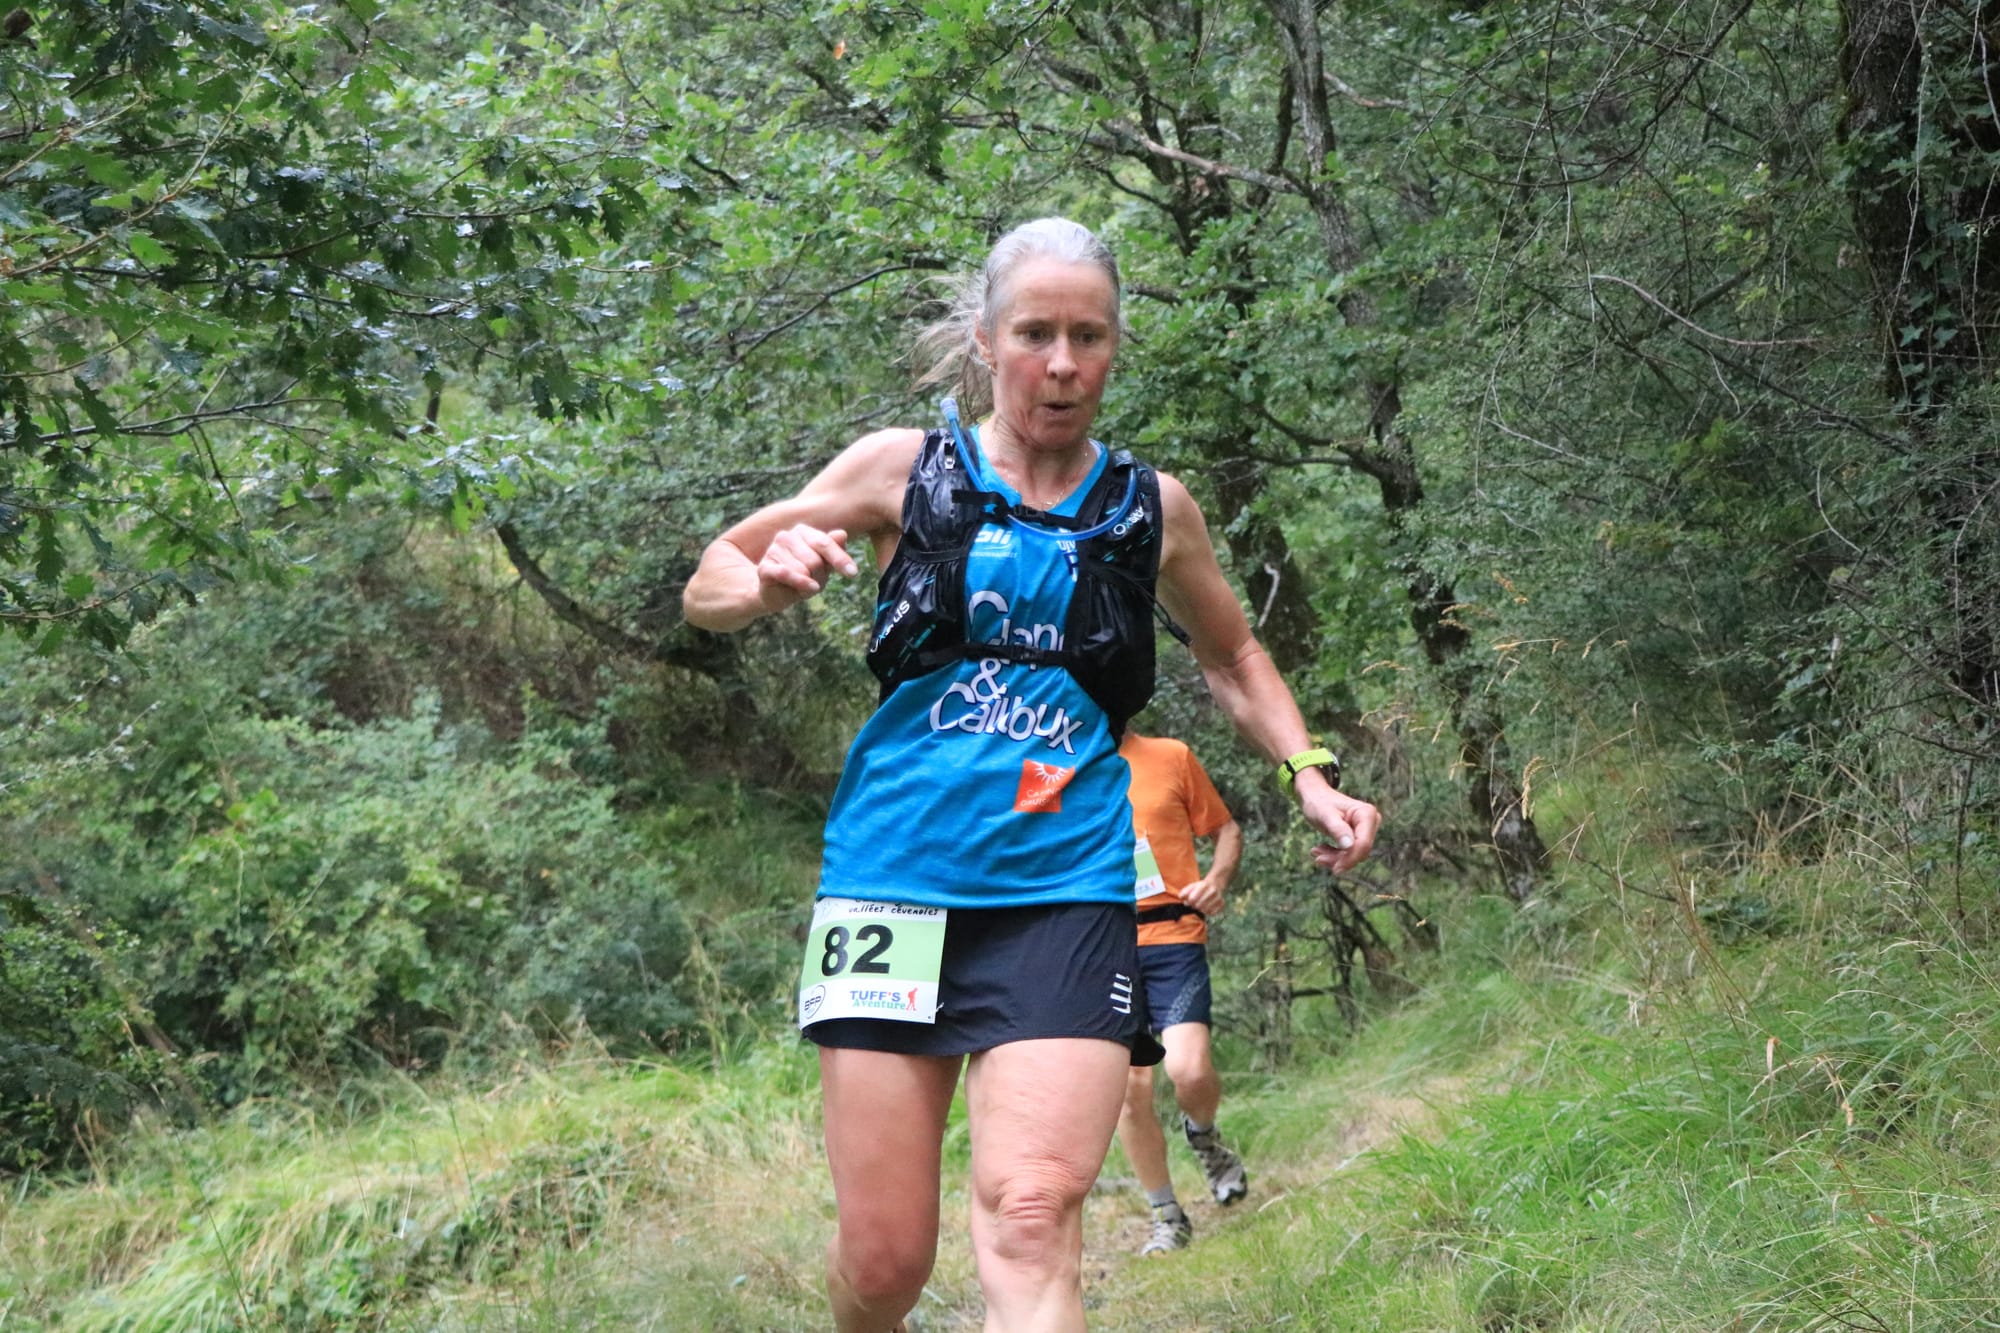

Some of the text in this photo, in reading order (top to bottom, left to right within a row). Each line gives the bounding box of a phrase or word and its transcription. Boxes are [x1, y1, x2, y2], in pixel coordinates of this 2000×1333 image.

[971, 657, 1007, 701] &
[929, 682, 1084, 755] Cailloux
[848, 903, 938, 916] vallées cévenoles
[821, 924, 894, 976] 82
[849, 990, 902, 1002] TUFF'S
[852, 998, 906, 1010] Aventure
